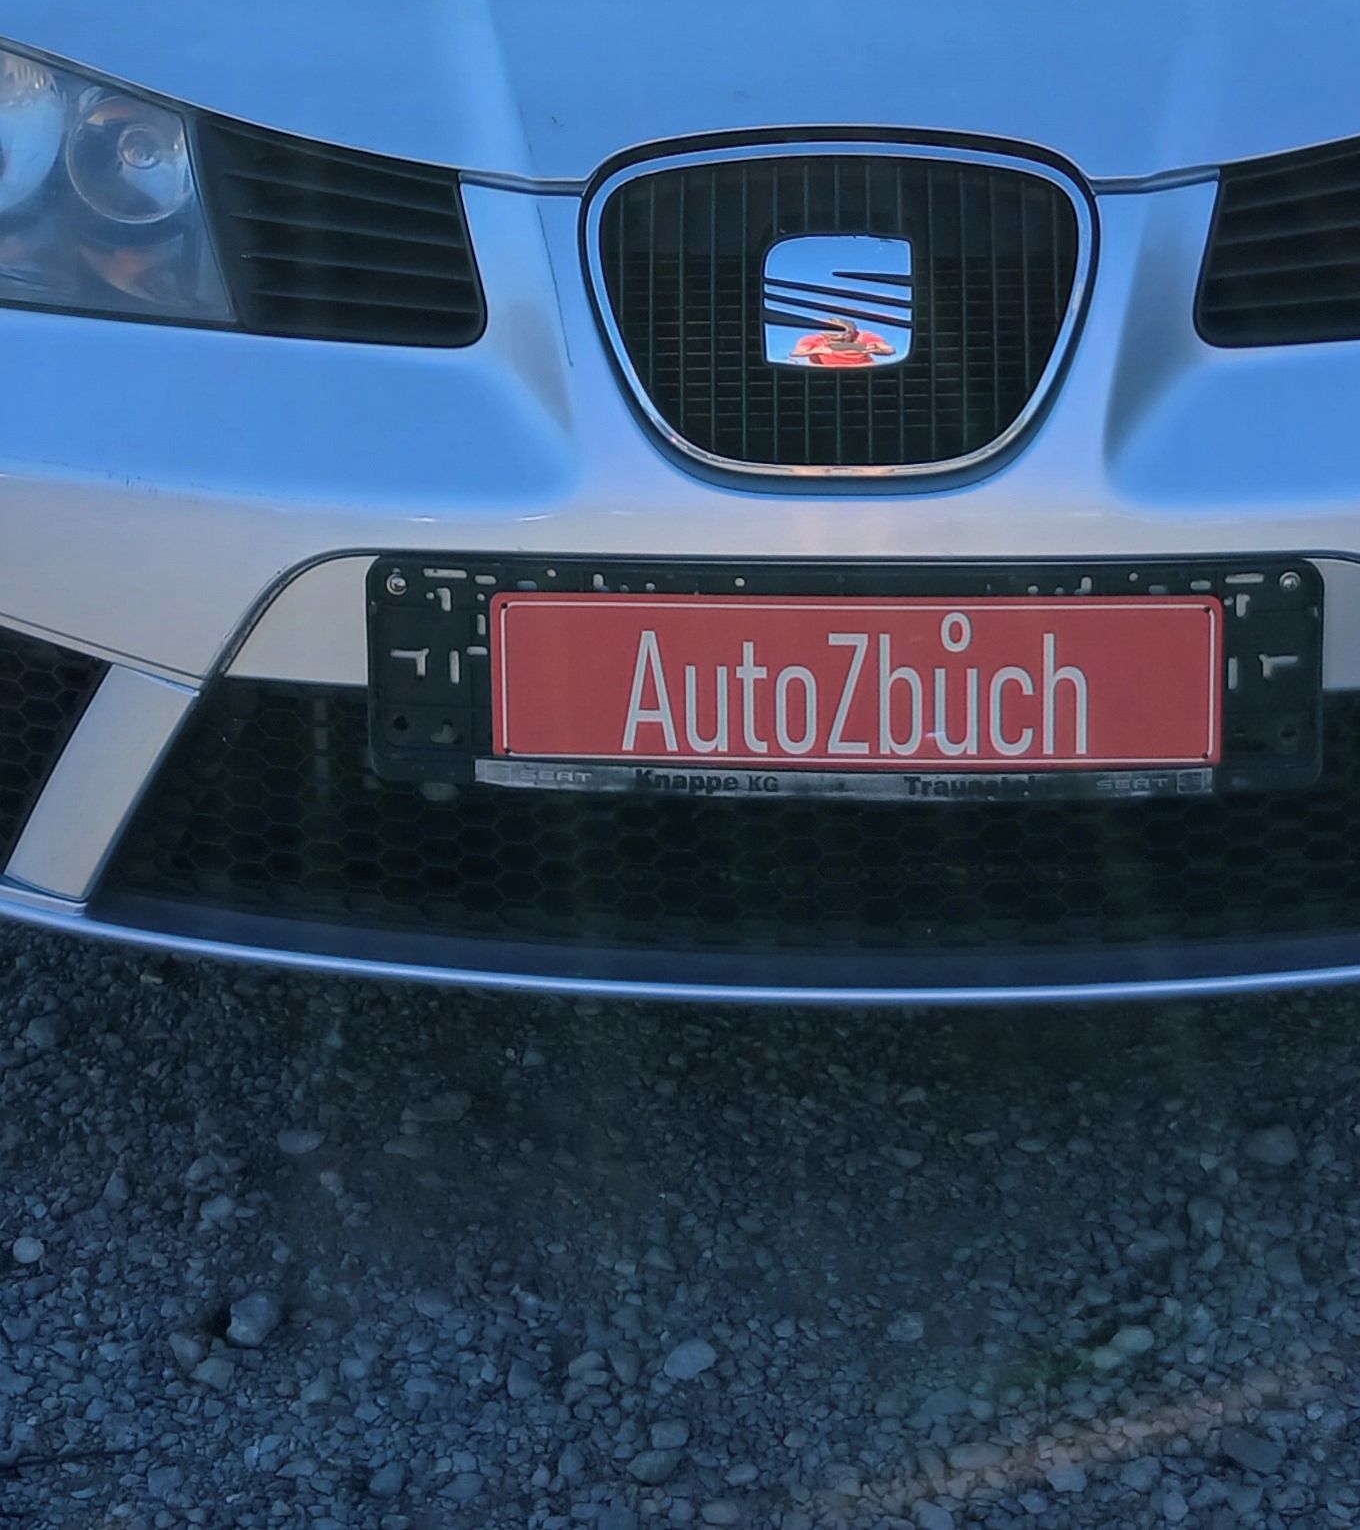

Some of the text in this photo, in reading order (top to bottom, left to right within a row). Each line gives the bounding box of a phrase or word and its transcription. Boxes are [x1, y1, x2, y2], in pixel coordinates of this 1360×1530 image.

[621, 612, 1089, 756] AutoZbůch
[635, 769, 739, 794] Knappe
[746, 774, 780, 793] KG
[1095, 777, 1169, 791] SEAT
